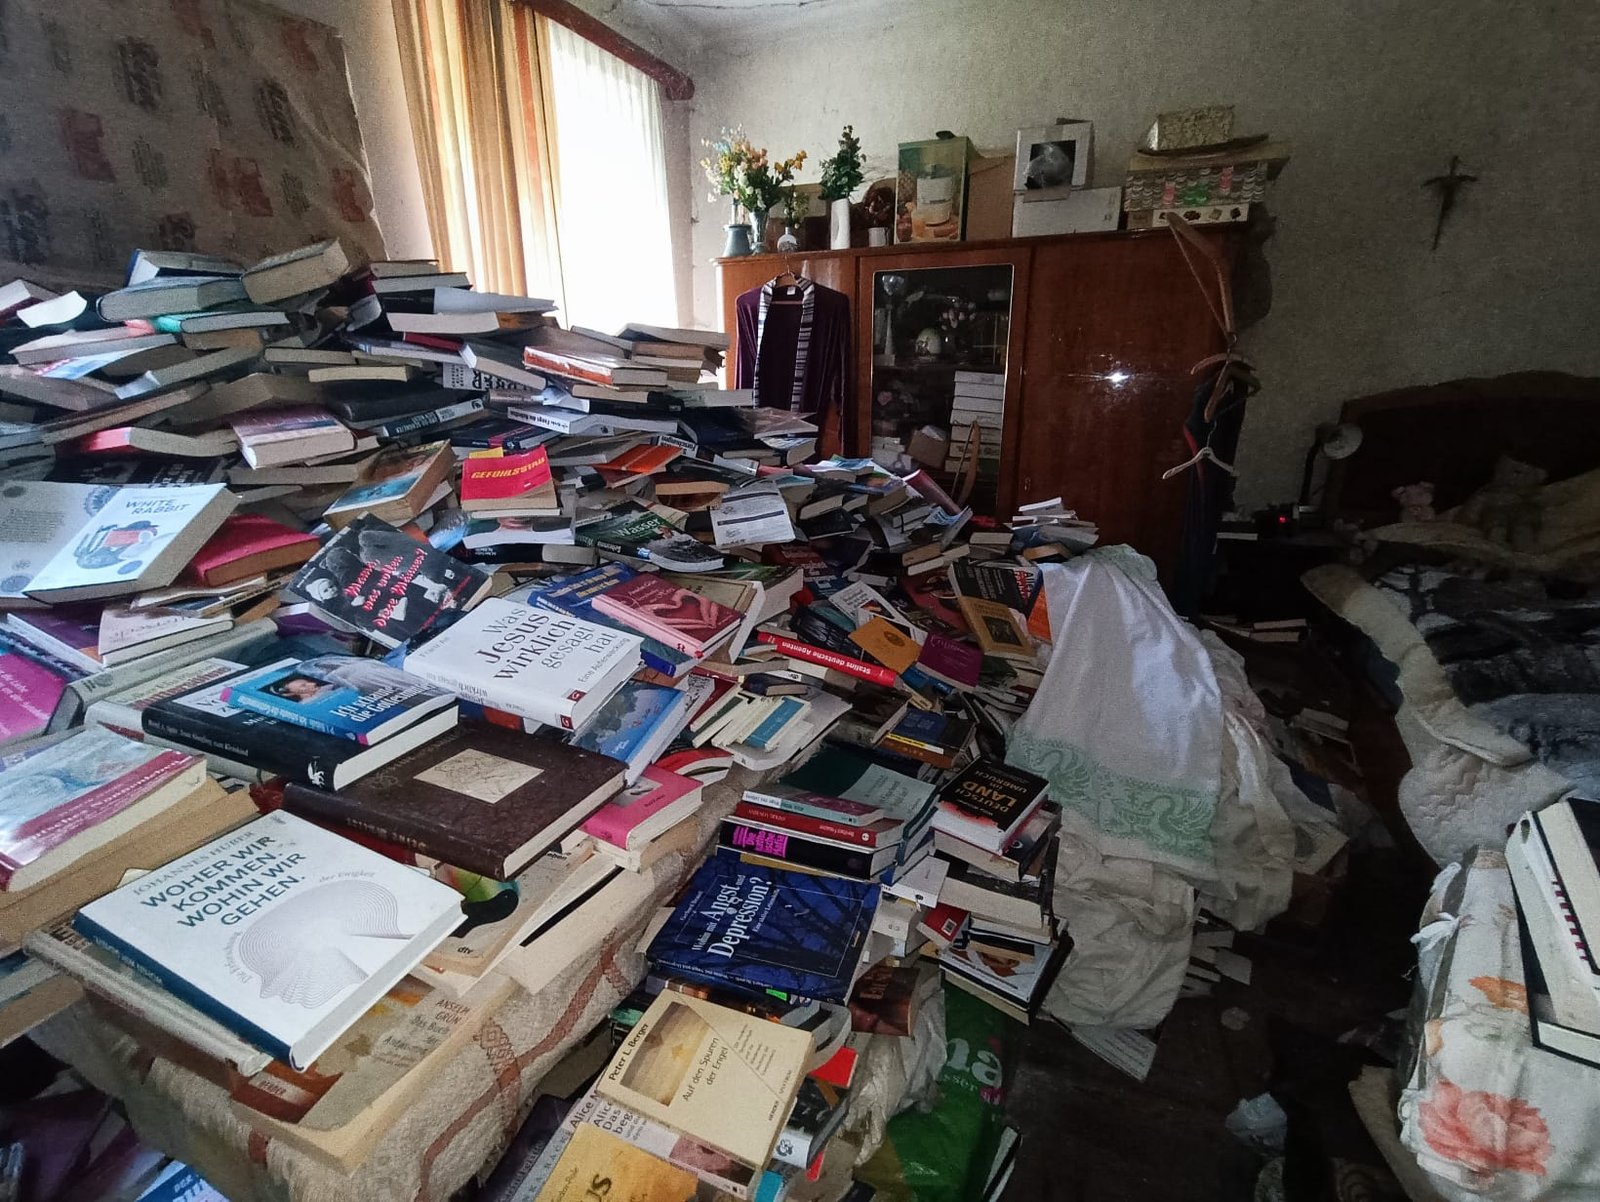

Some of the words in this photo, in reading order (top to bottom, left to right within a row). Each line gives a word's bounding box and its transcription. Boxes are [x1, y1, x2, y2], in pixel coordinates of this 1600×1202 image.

[125, 499, 178, 509] WHITE
[131, 503, 192, 515] RABBIT
[615, 517, 661, 536] Wasser
[482, 608, 527, 634] Was
[476, 613, 550, 664] Jesus
[493, 620, 576, 679] wirklich
[541, 626, 595, 669] gesagt
[585, 632, 618, 654] hat
[782, 642, 812, 657] Agenten
[812, 651, 846, 666] deutsche
[846, 662, 871, 675] Stalins
[330, 700, 356, 717] Ich
[350, 708, 376, 722] die
[962, 780, 1017, 808] LAND
[974, 769, 1028, 794] UMBRUCH
[955, 788, 1009, 813] DEUTSCH
[140, 858, 233, 908] WOHER
[231, 836, 276, 861] WIR
[172, 851, 283, 912] KOMMEN.
[177, 878, 264, 927] WOHIN
[261, 852, 307, 879] WIR
[221, 875, 306, 926] GEHEN.
[700, 884, 743, 922] Angst
[706, 876, 772, 959] Depression?
[457, 945, 474, 955] dtv
[435, 999, 471, 1015] ANSELM
[608, 1057, 627, 1082] Peter
[624, 1048, 633, 1059] L.
[629, 1022, 650, 1049] Berger
[682, 1083, 696, 1102] Auf
[692, 1066, 705, 1084] den
[700, 1037, 720, 1067] Spuren
[706, 1069, 718, 1086] der
[713, 1046, 729, 1070] Engel
[570, 1101, 595, 1129] Alice
[602, 1109, 622, 1131] Das
